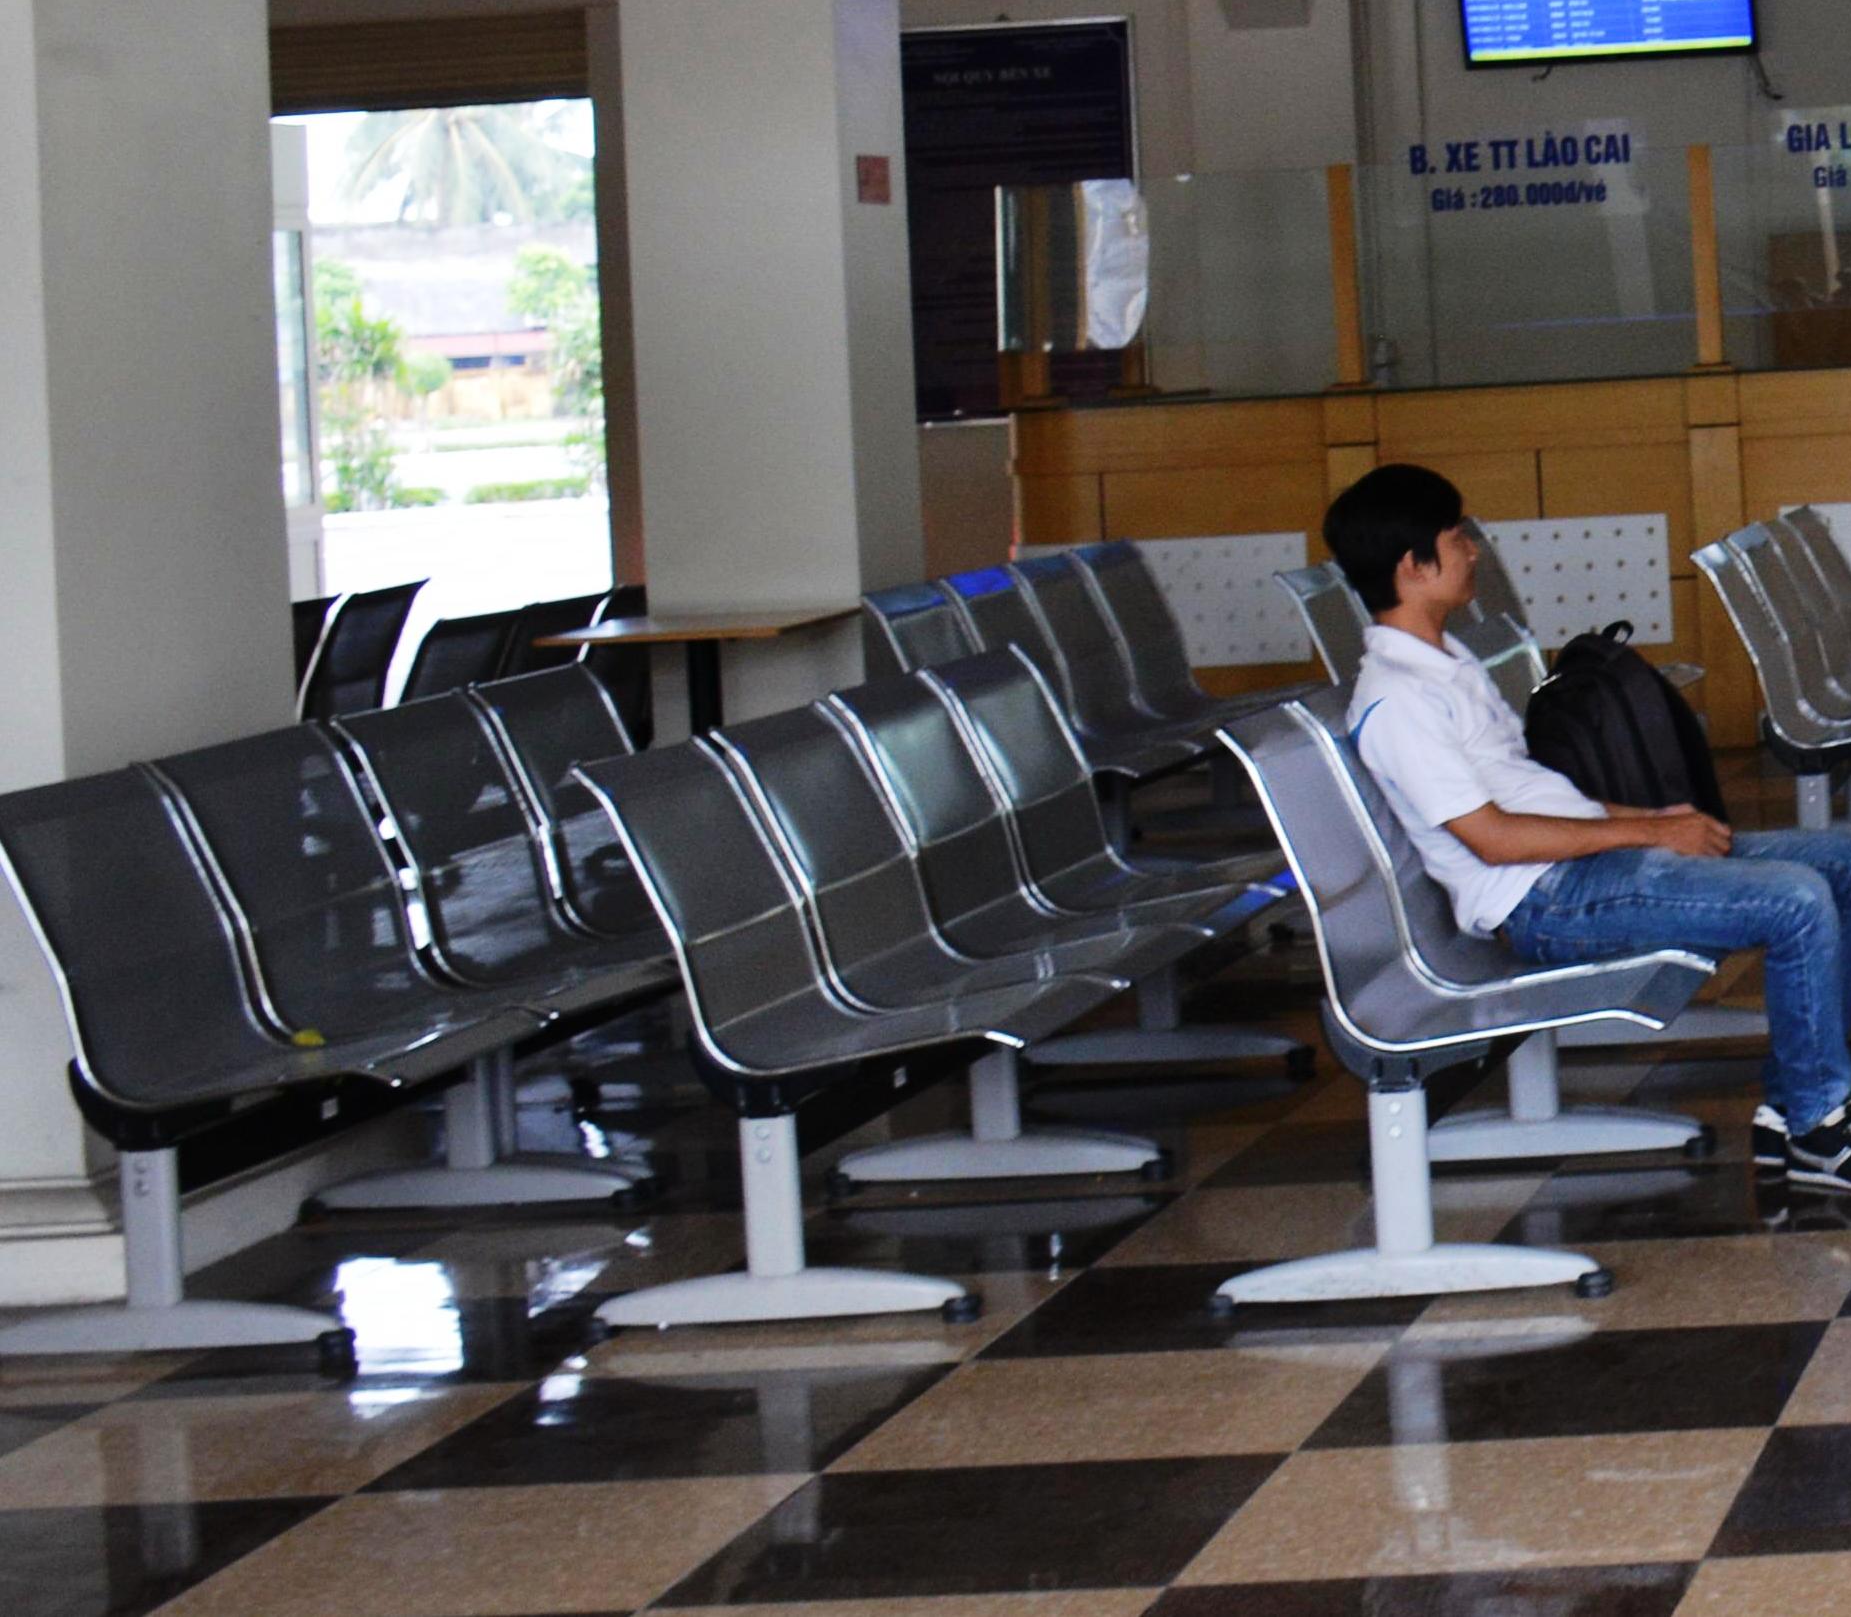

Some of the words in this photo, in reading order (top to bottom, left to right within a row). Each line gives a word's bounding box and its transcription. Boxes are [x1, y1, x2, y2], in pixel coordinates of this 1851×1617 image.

[1409, 143, 1436, 174] B.
[1446, 142, 1480, 173] XE
[1489, 140, 1518, 170] TT
[1584, 133, 1631, 164] CAI
[1787, 123, 1830, 153] GIA
